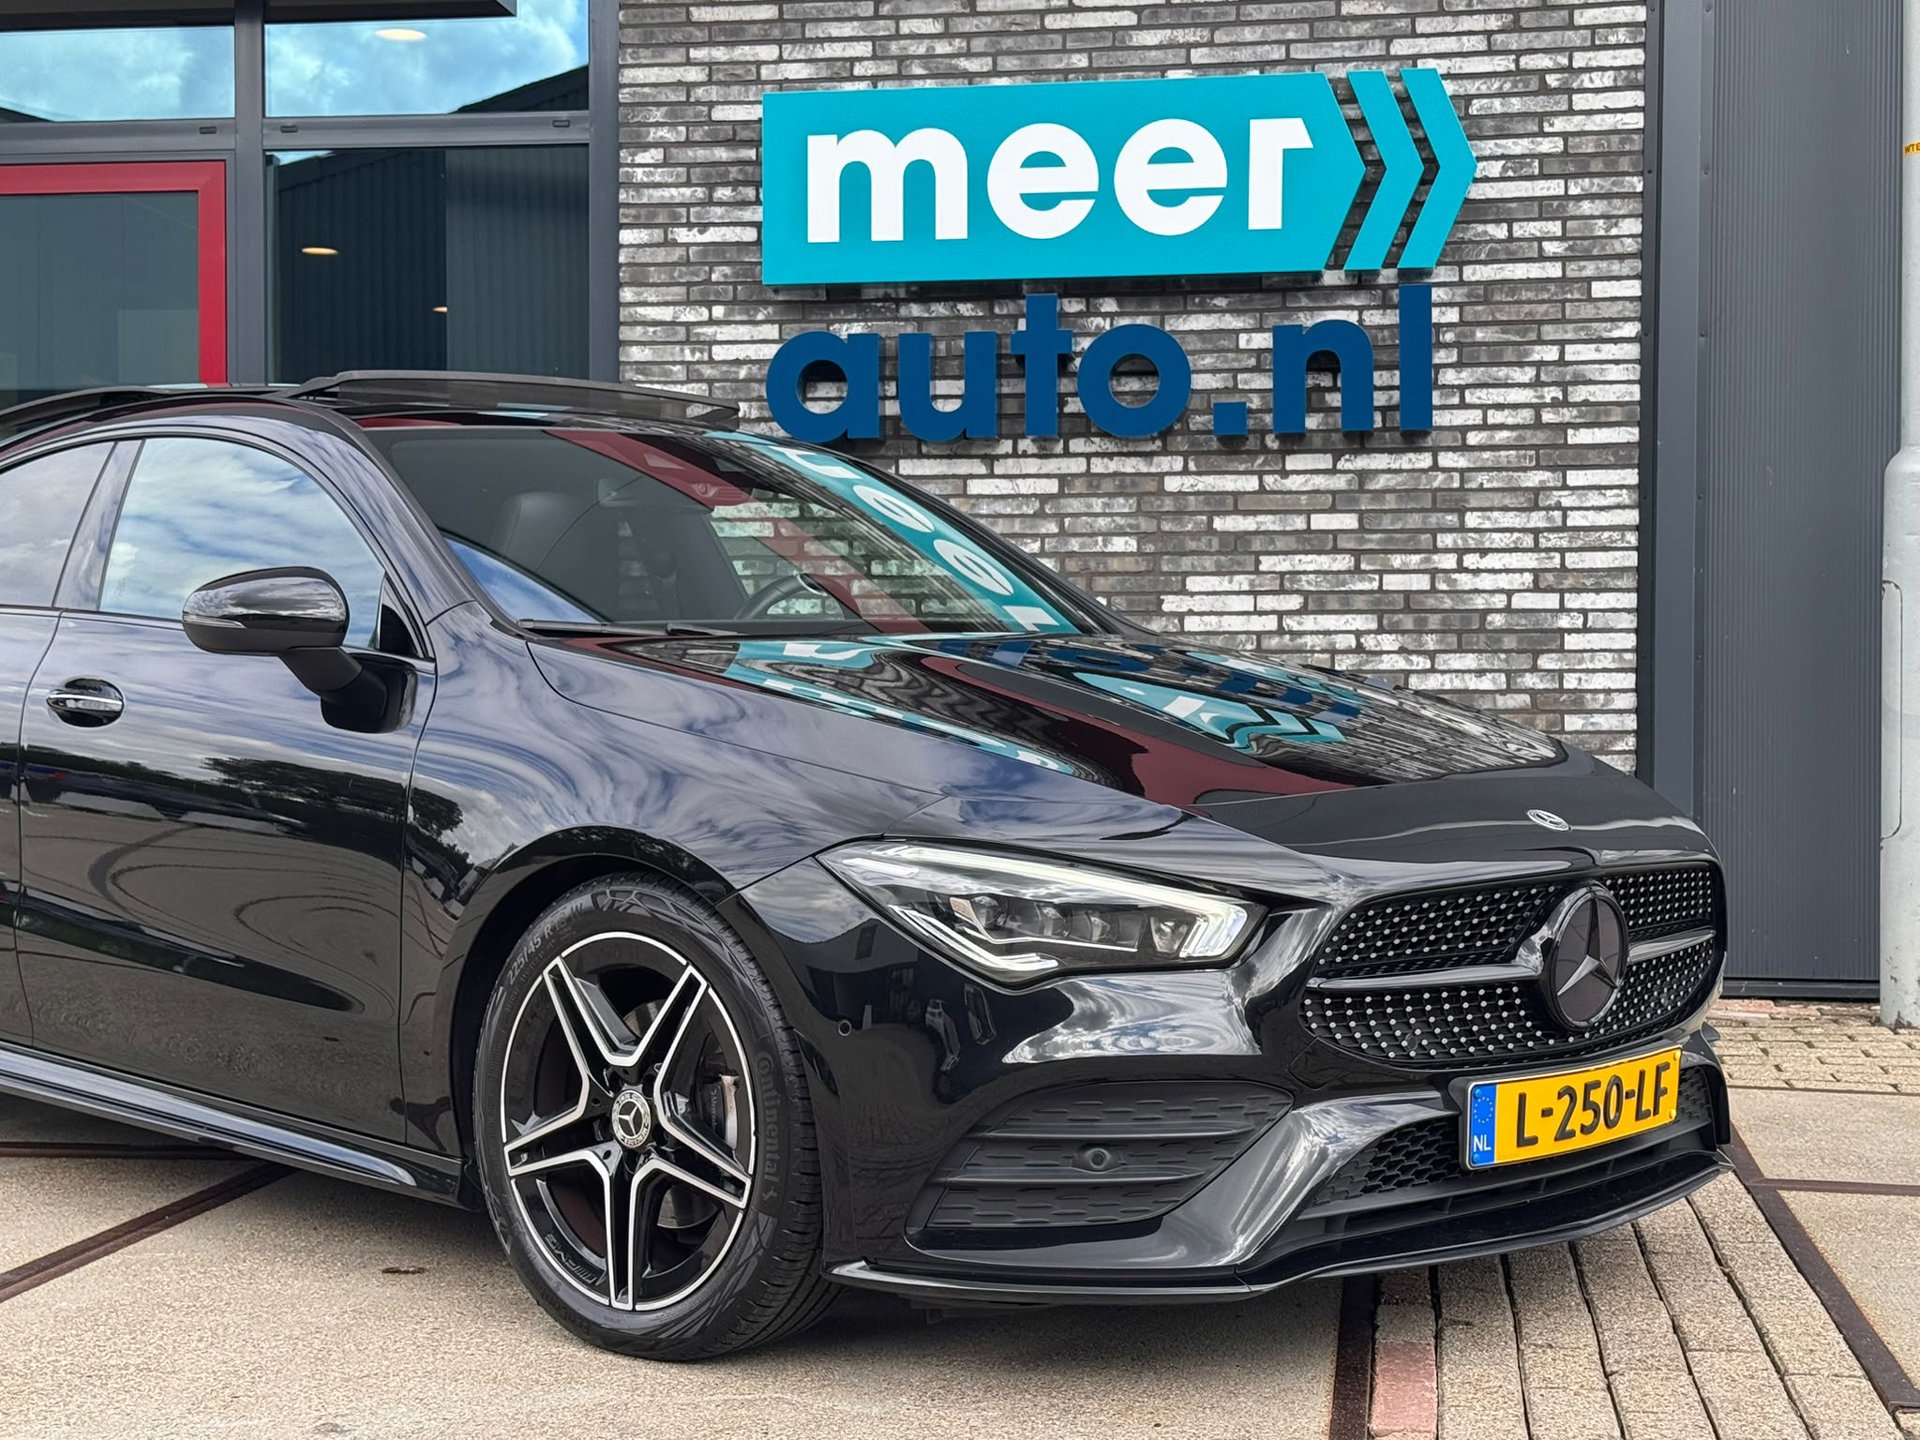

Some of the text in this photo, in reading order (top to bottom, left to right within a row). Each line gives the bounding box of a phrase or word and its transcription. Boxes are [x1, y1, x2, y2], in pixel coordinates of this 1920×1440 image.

[807, 117, 1314, 243] meer
[765, 283, 1434, 443] auto.nl
[506, 934, 542, 986] 225/45
[757, 1051, 781, 1182] Continental
[1473, 1134, 1492, 1152] NL
[1516, 1061, 1671, 1149] L-250-LF
